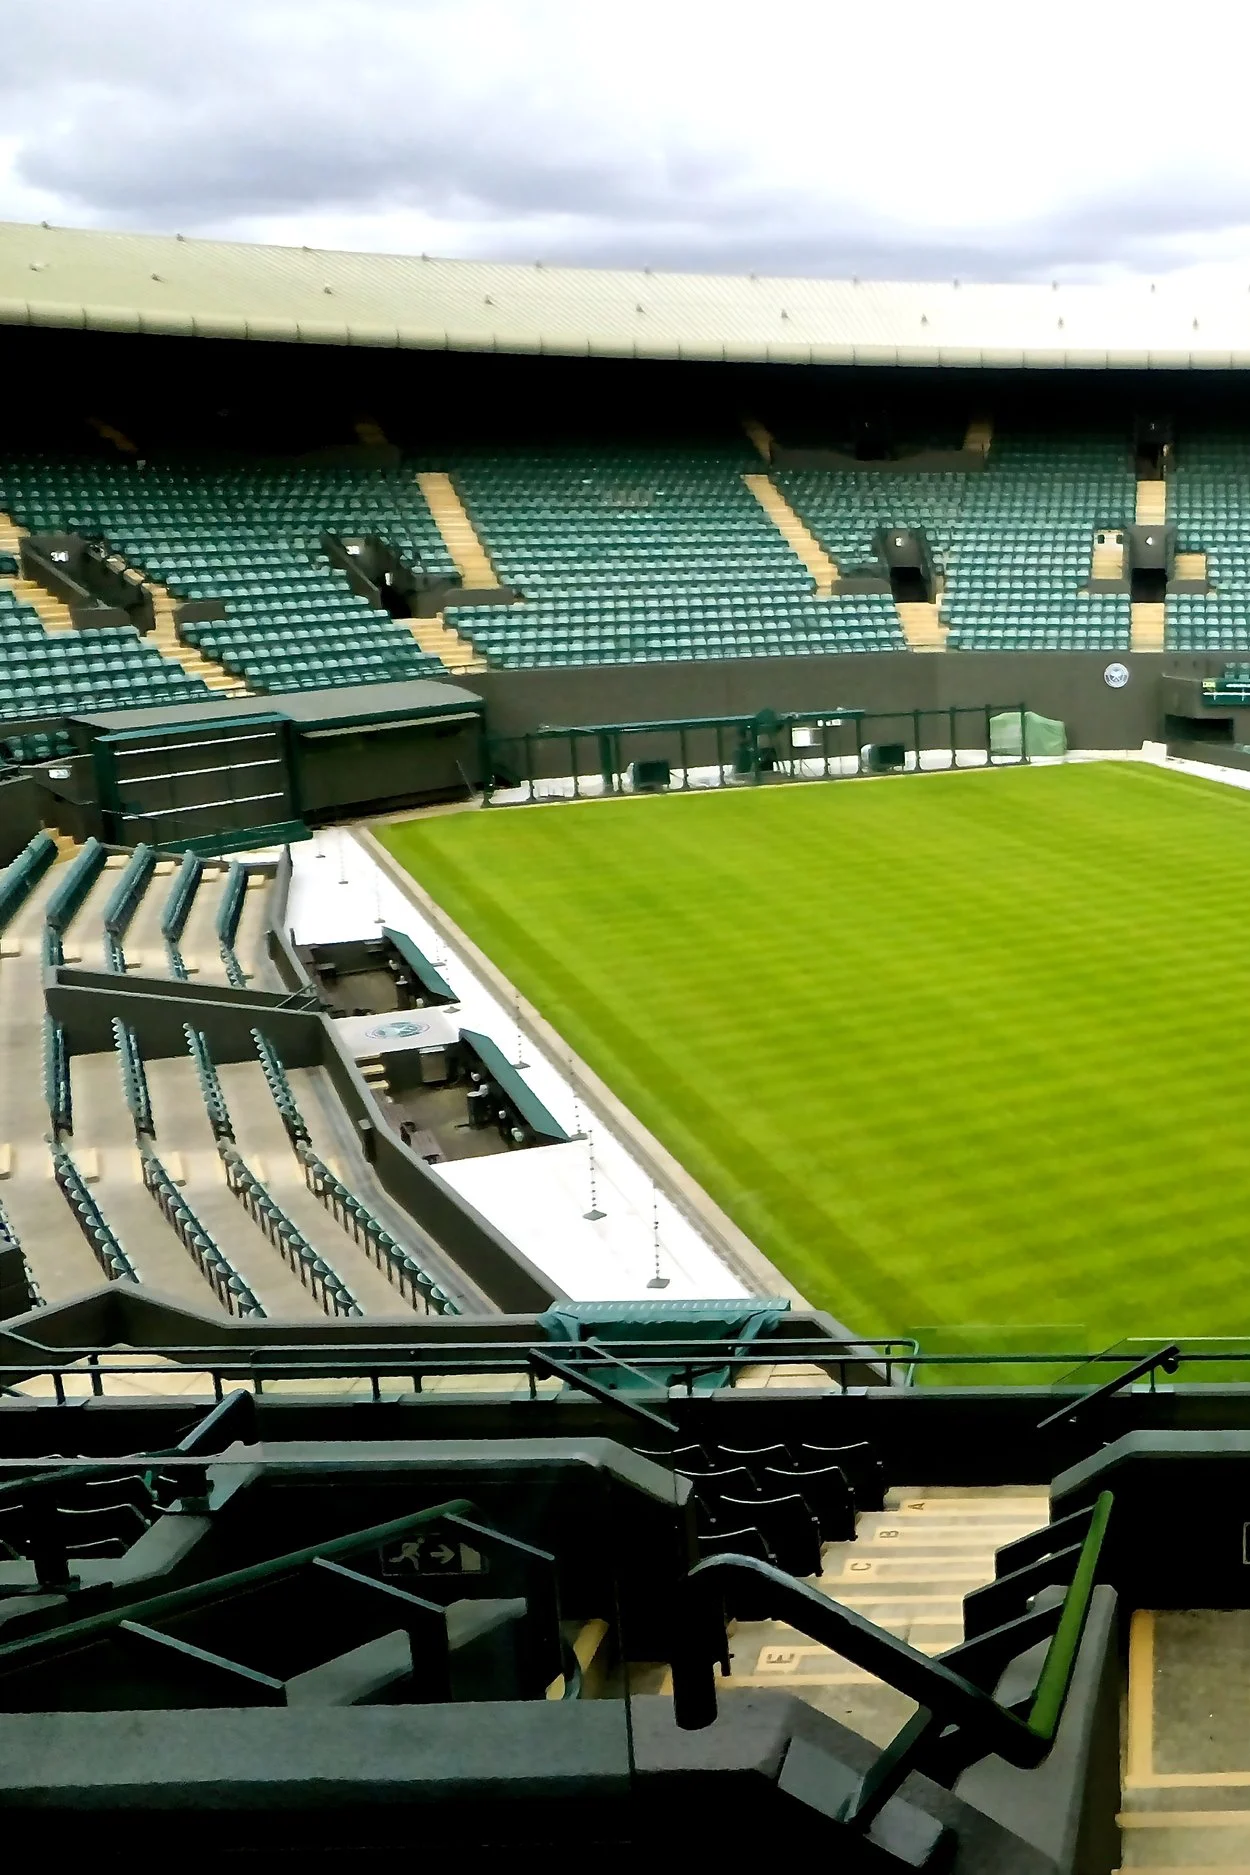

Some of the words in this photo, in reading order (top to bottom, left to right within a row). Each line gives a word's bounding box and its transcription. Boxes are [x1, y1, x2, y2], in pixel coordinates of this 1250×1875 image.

[908, 1502, 926, 1511] A
[879, 1530, 899, 1538] B
[851, 1562, 872, 1571] C
[766, 1653, 796, 1664] E
